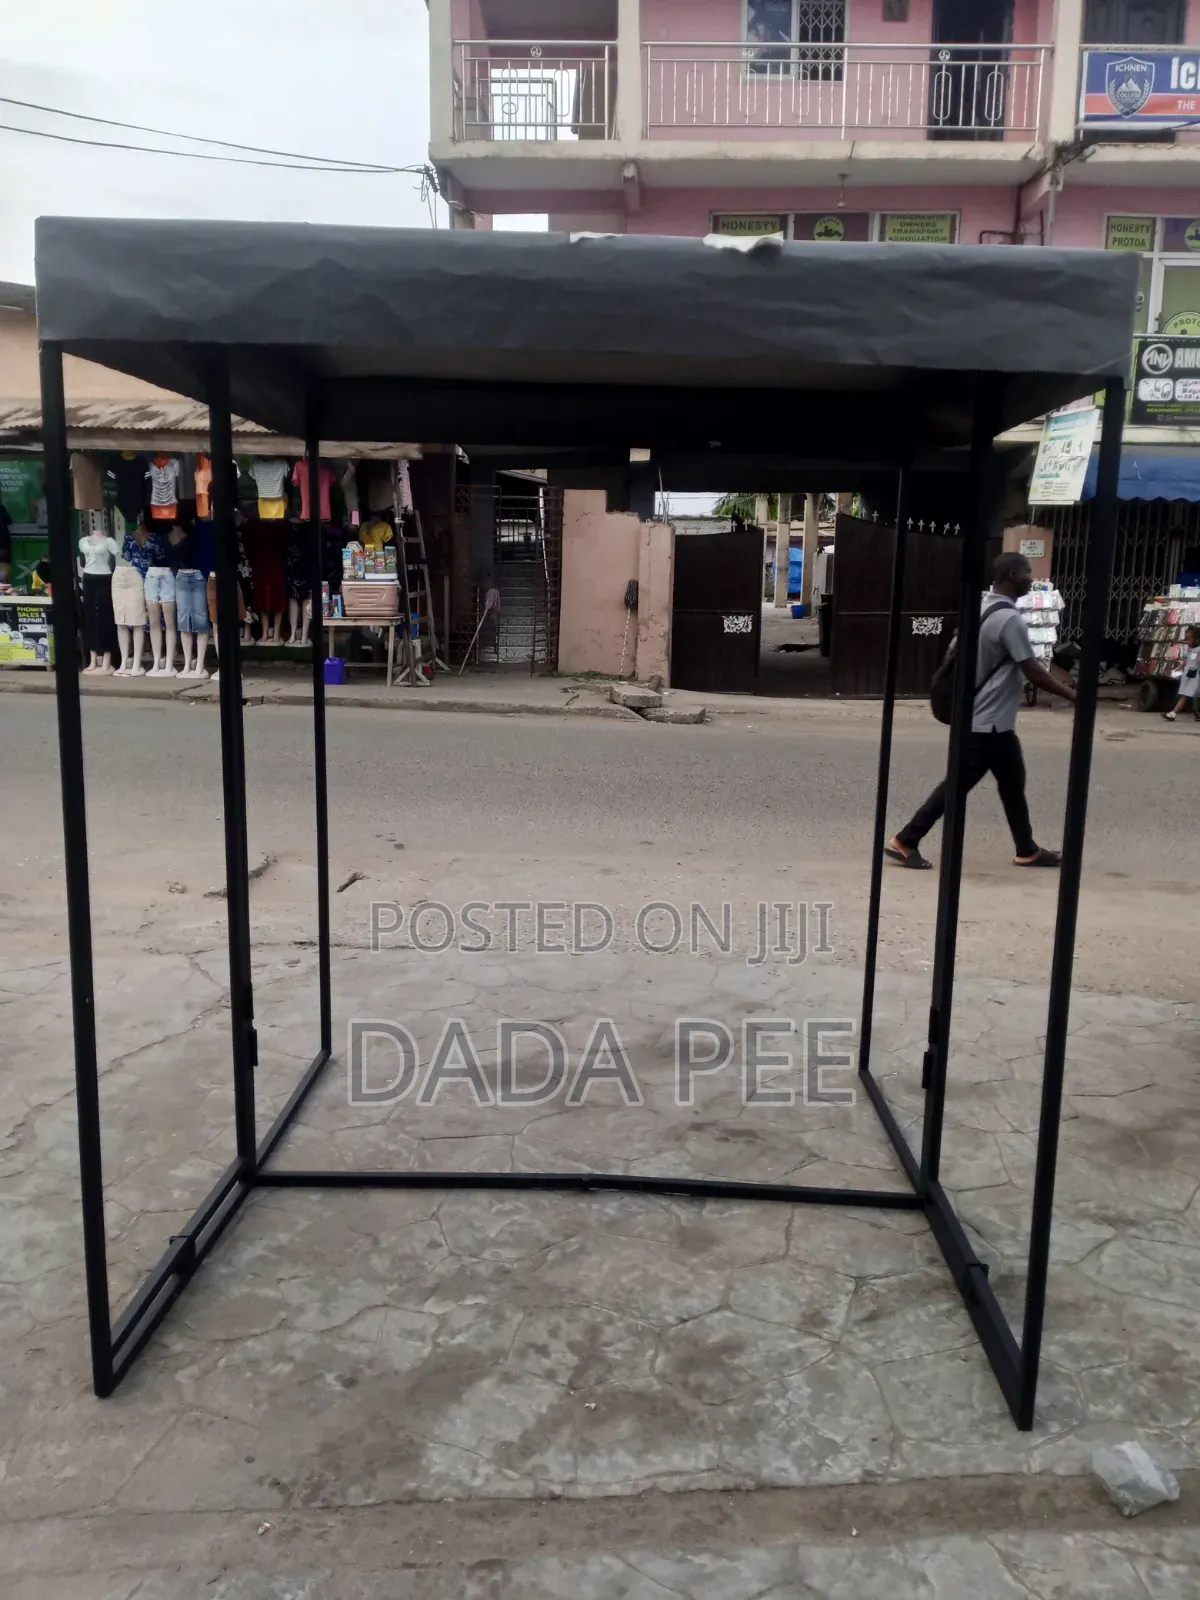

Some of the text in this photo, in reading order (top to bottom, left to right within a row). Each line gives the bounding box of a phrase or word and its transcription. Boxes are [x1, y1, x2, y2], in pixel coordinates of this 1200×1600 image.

[1115, 64, 1147, 72] ICHNEN
[1170, 56, 1200, 90] Ic
[1176, 99, 1196, 110] THE
[722, 220, 778, 231] HONESTY
[1110, 222, 1151, 234] HONESTY
[1112, 236, 1146, 247] PROTOA
